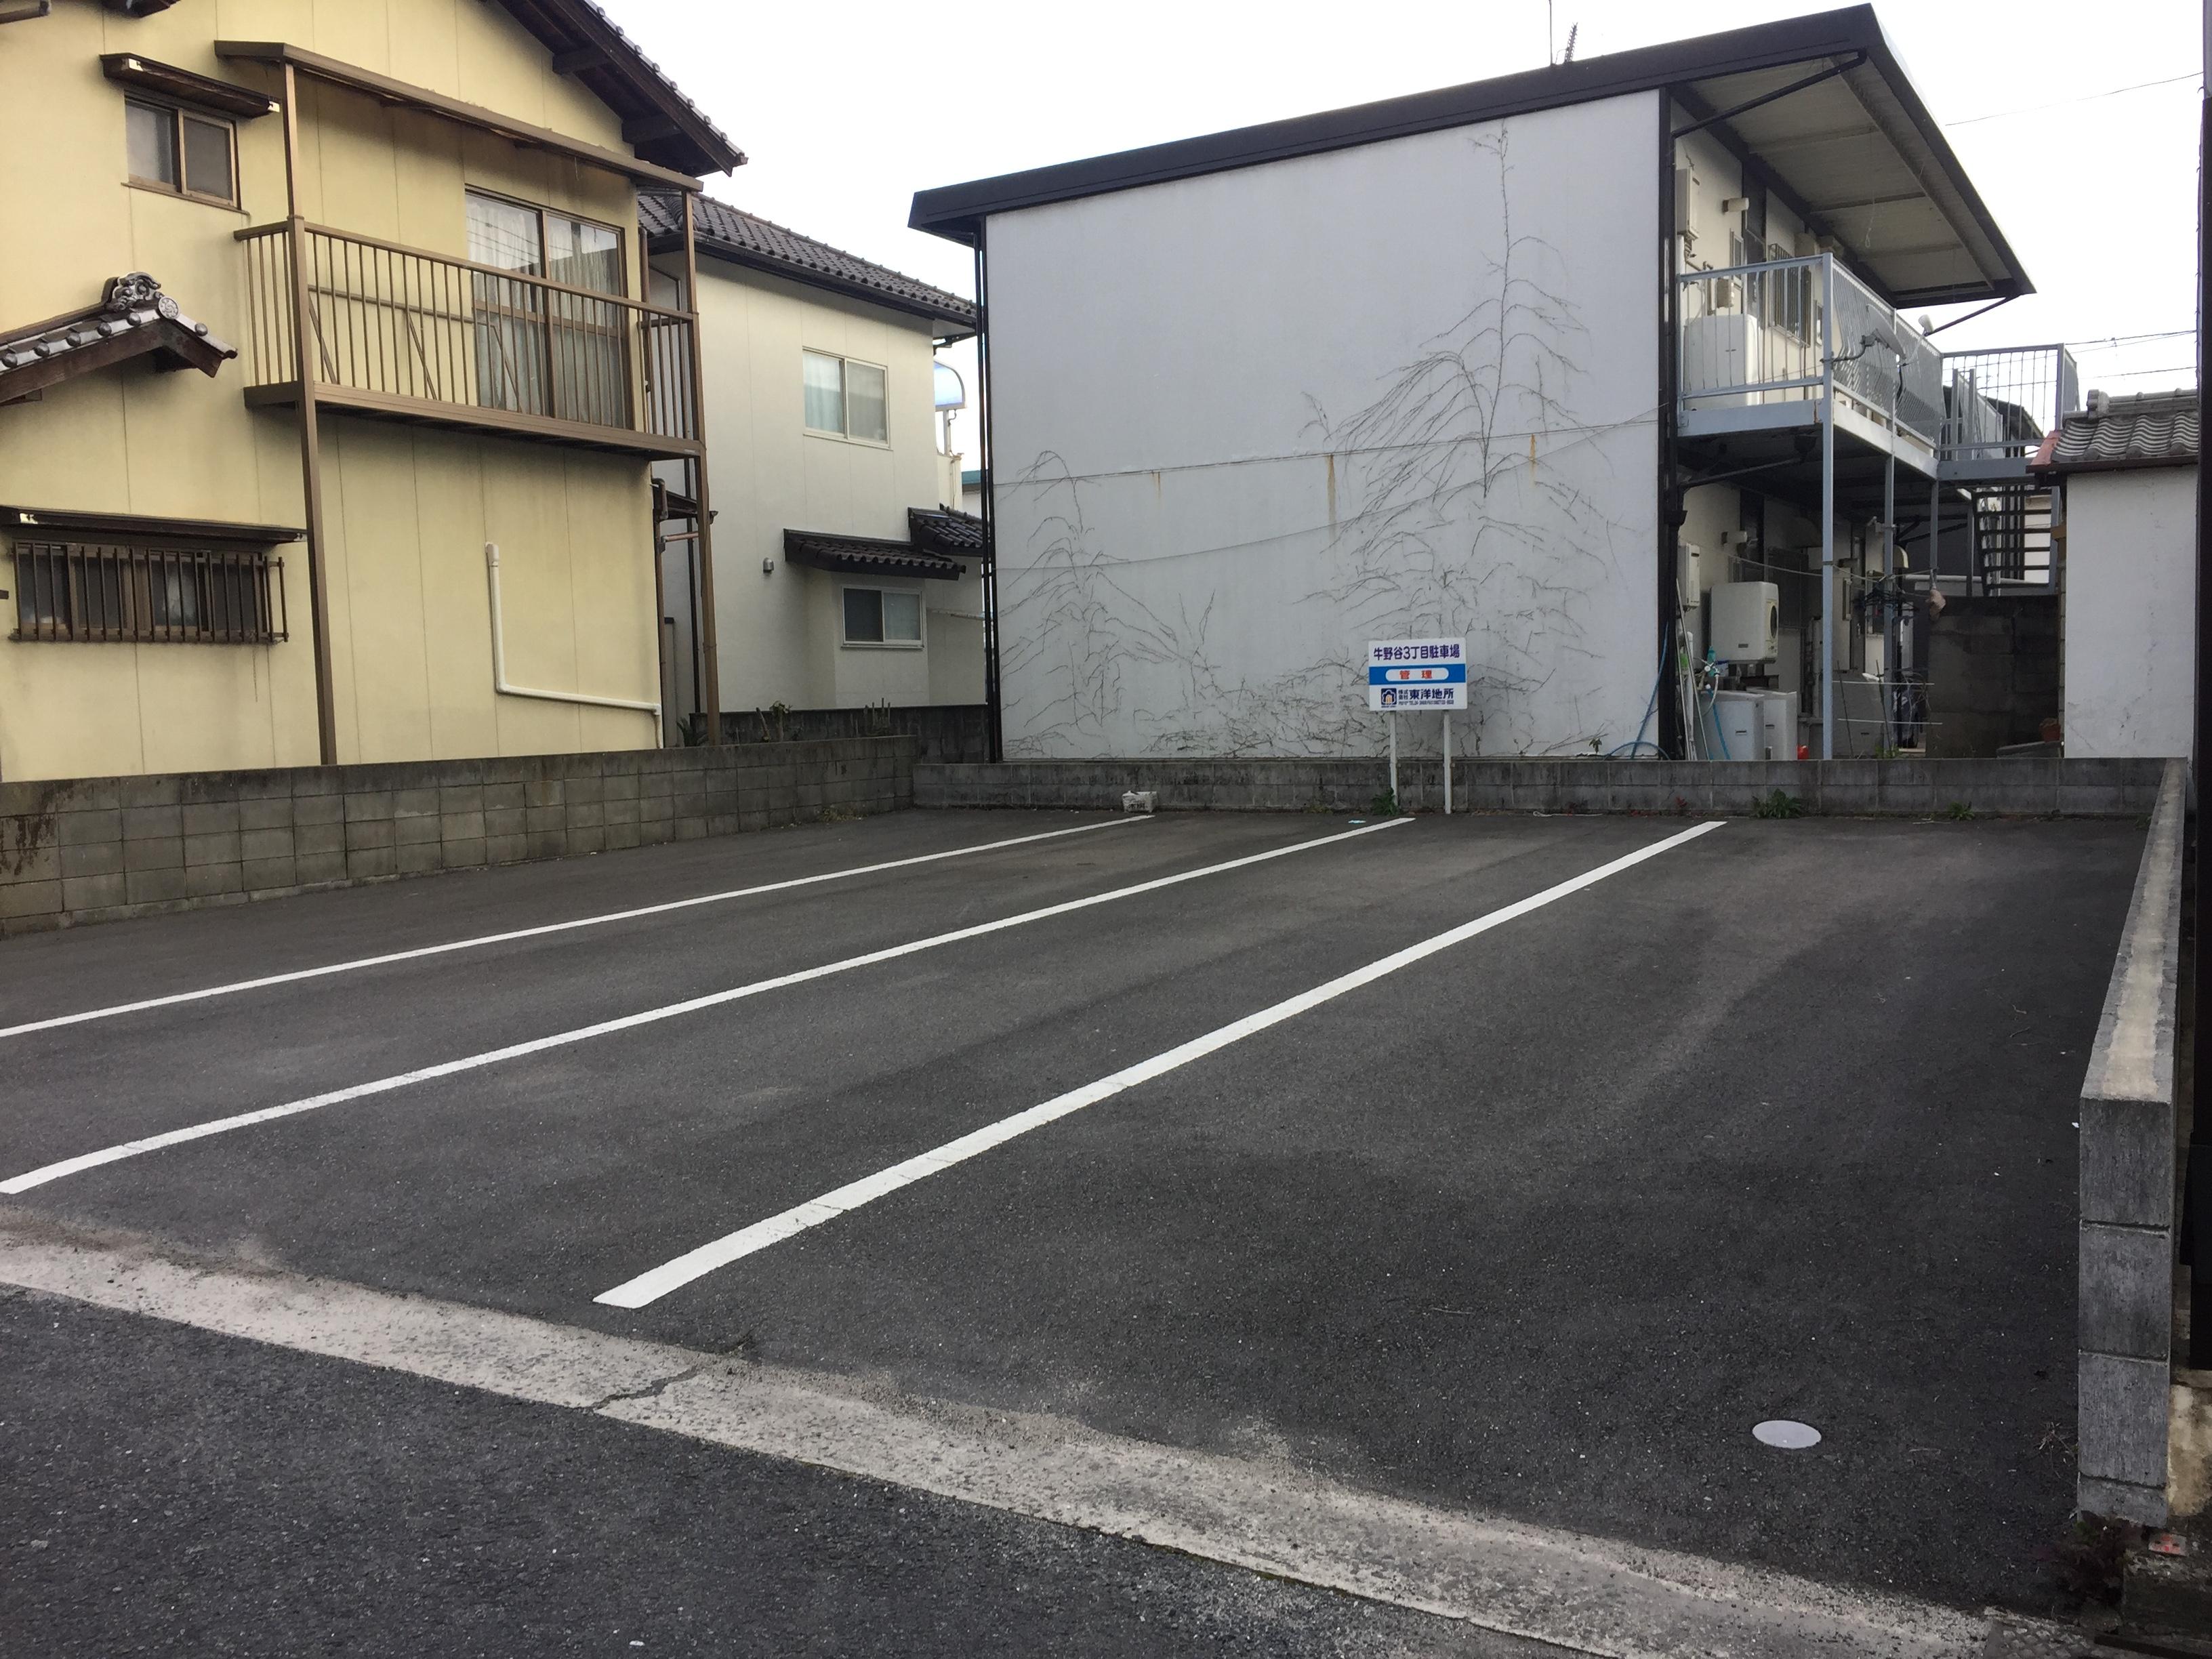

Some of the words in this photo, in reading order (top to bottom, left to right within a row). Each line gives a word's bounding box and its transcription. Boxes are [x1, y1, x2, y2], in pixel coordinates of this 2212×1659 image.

[1374, 644, 1460, 660] 牛野谷3丁目駐車場
[1409, 688, 1454, 700] 東洋地所
